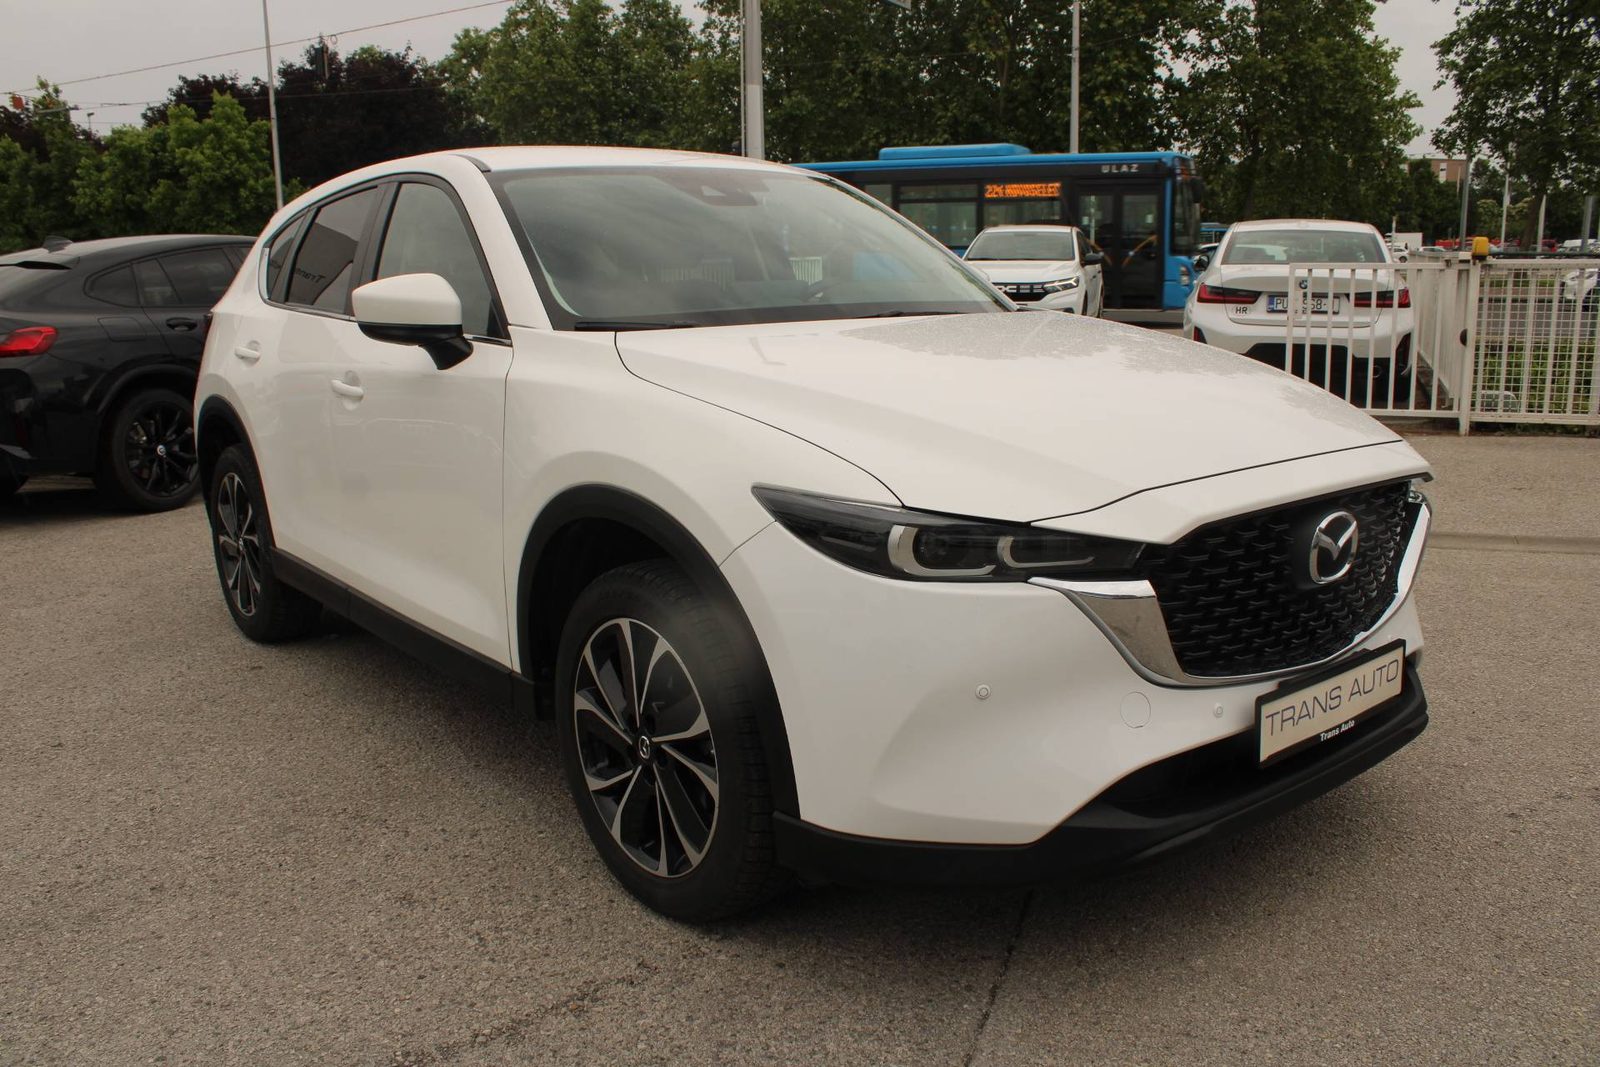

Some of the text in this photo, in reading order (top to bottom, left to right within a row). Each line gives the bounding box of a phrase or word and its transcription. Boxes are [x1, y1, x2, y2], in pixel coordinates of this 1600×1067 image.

[1101, 164, 1138, 173] ULAZ
[1265, 659, 1399, 736] TRANS AUTO
[1320, 719, 1355, 742] Trans Auto
